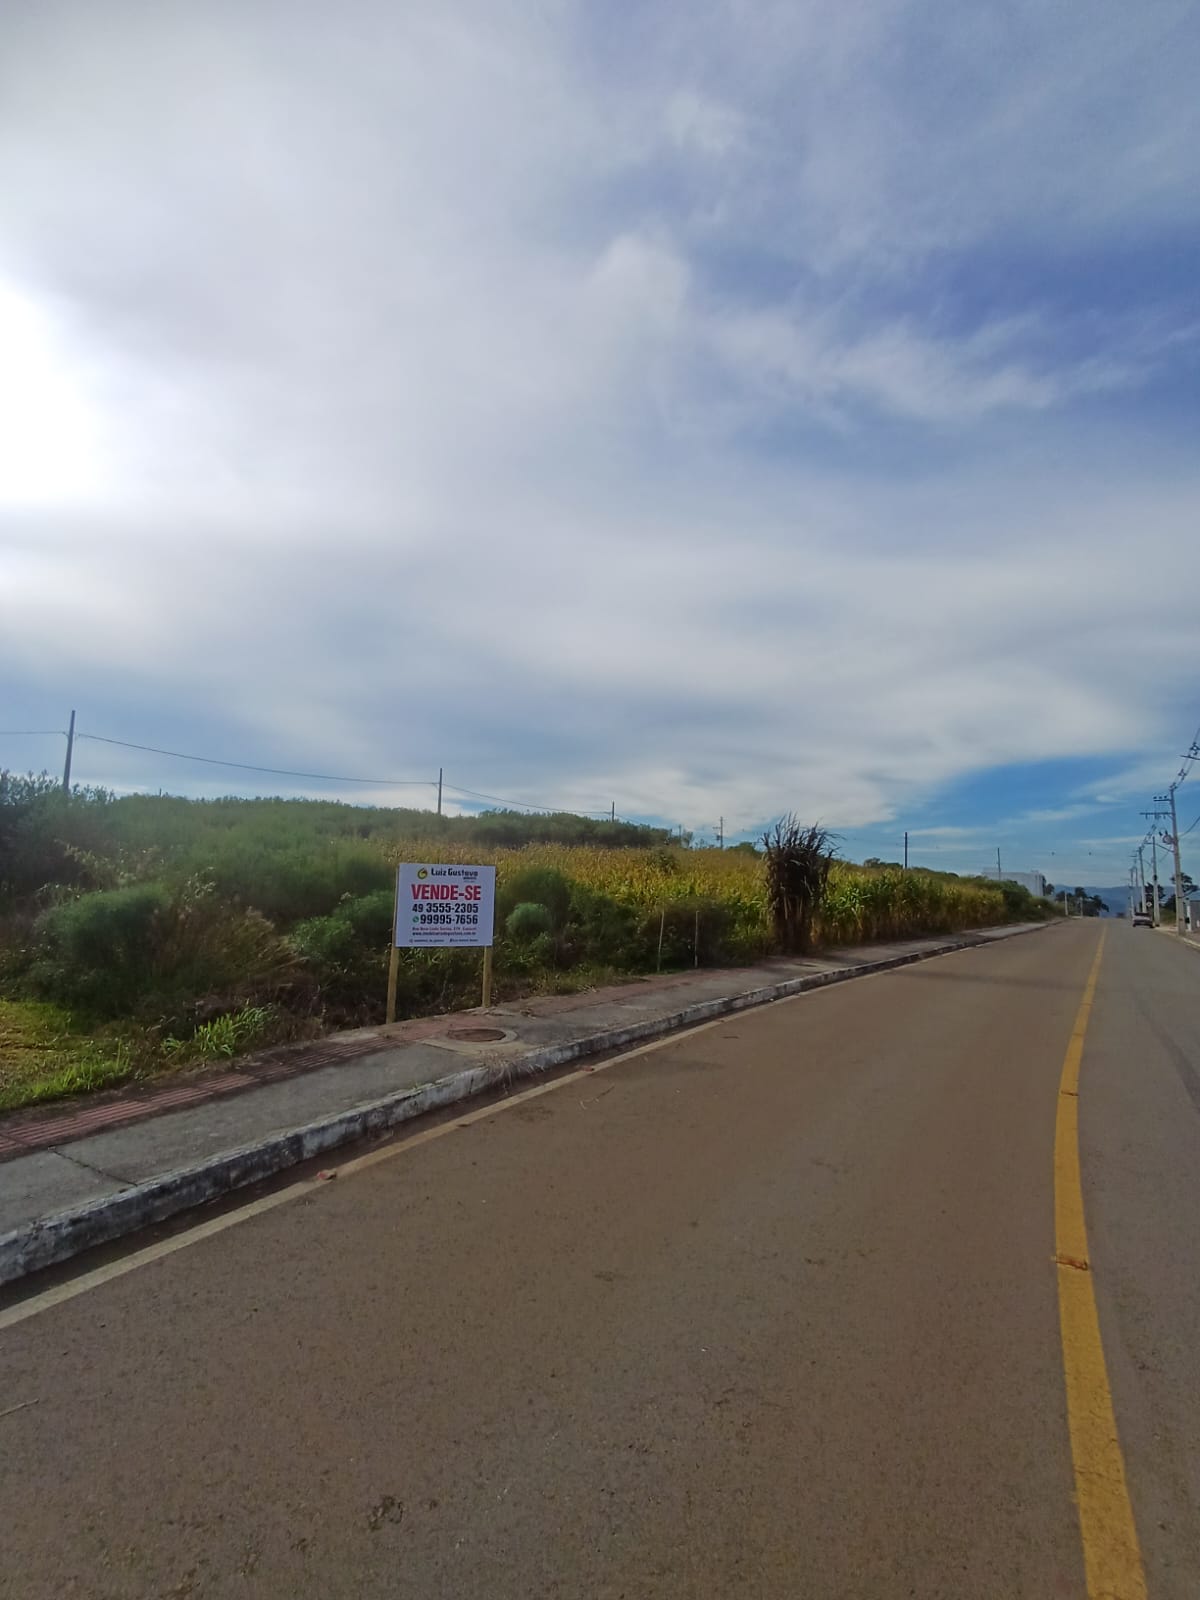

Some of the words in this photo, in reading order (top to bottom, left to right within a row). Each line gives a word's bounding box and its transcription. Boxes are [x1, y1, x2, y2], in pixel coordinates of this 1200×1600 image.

[431, 868, 447, 877] Luiz
[447, 868, 478, 877] Gustavo
[411, 884, 481, 901] VENDE-SE
[412, 903, 424, 913] 49
[425, 902, 479, 913] 3555-2305
[420, 914, 478, 925] 99995-7656
